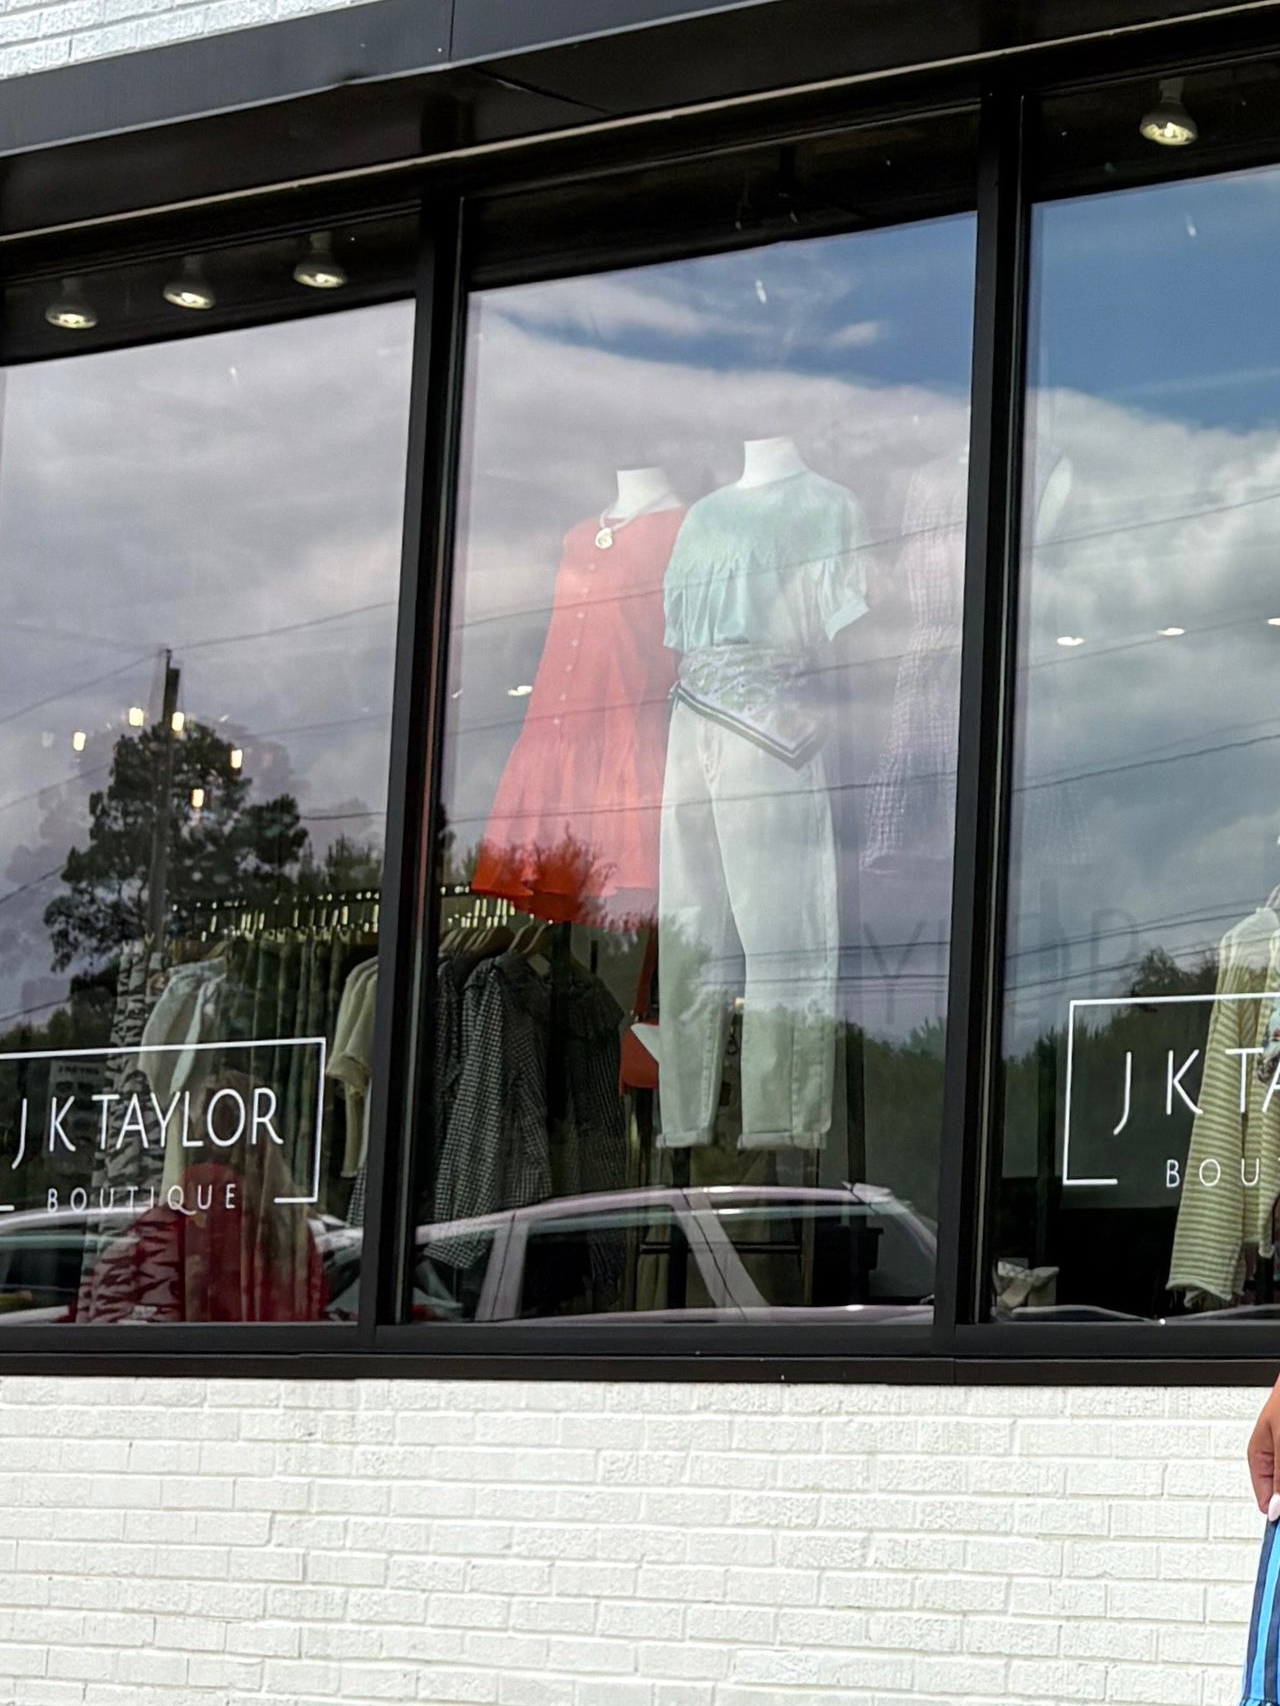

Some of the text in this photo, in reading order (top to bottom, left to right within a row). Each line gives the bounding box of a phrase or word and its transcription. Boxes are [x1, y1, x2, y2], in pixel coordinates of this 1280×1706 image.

[12, 1087, 284, 1169] J K TAYLOR
[1113, 1051, 1132, 1135] J
[1165, 1049, 1204, 1115] K
[46, 1183, 238, 1214] BOUTIQUE
